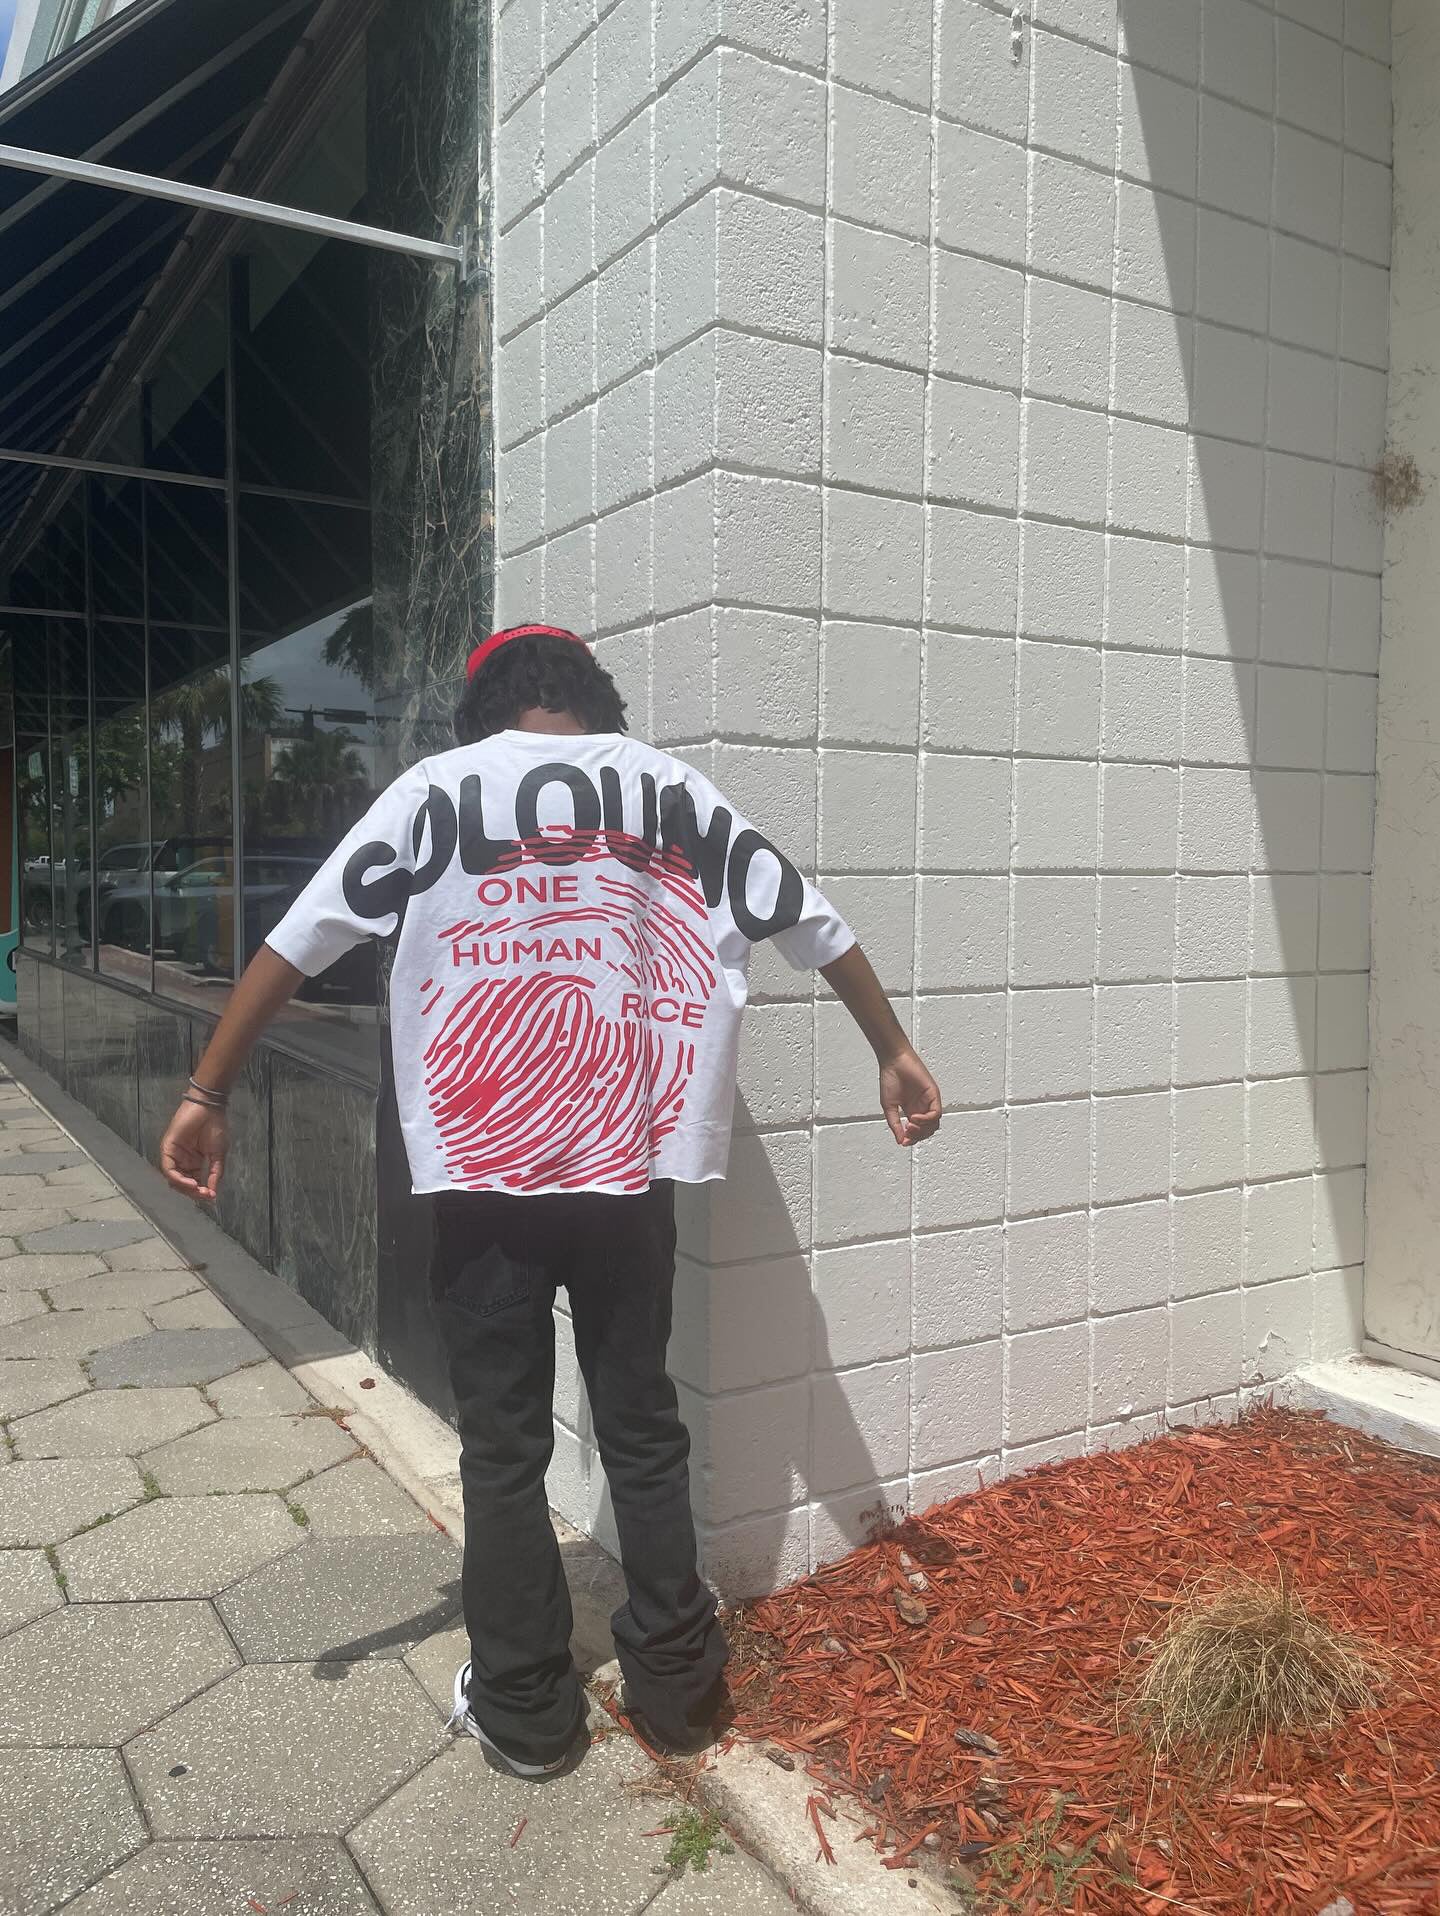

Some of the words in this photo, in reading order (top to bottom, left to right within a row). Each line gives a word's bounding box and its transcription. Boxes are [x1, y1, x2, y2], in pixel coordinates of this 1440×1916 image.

[477, 875, 578, 906] ONE
[452, 937, 601, 967] HUMAN
[621, 993, 707, 1029] RACE
